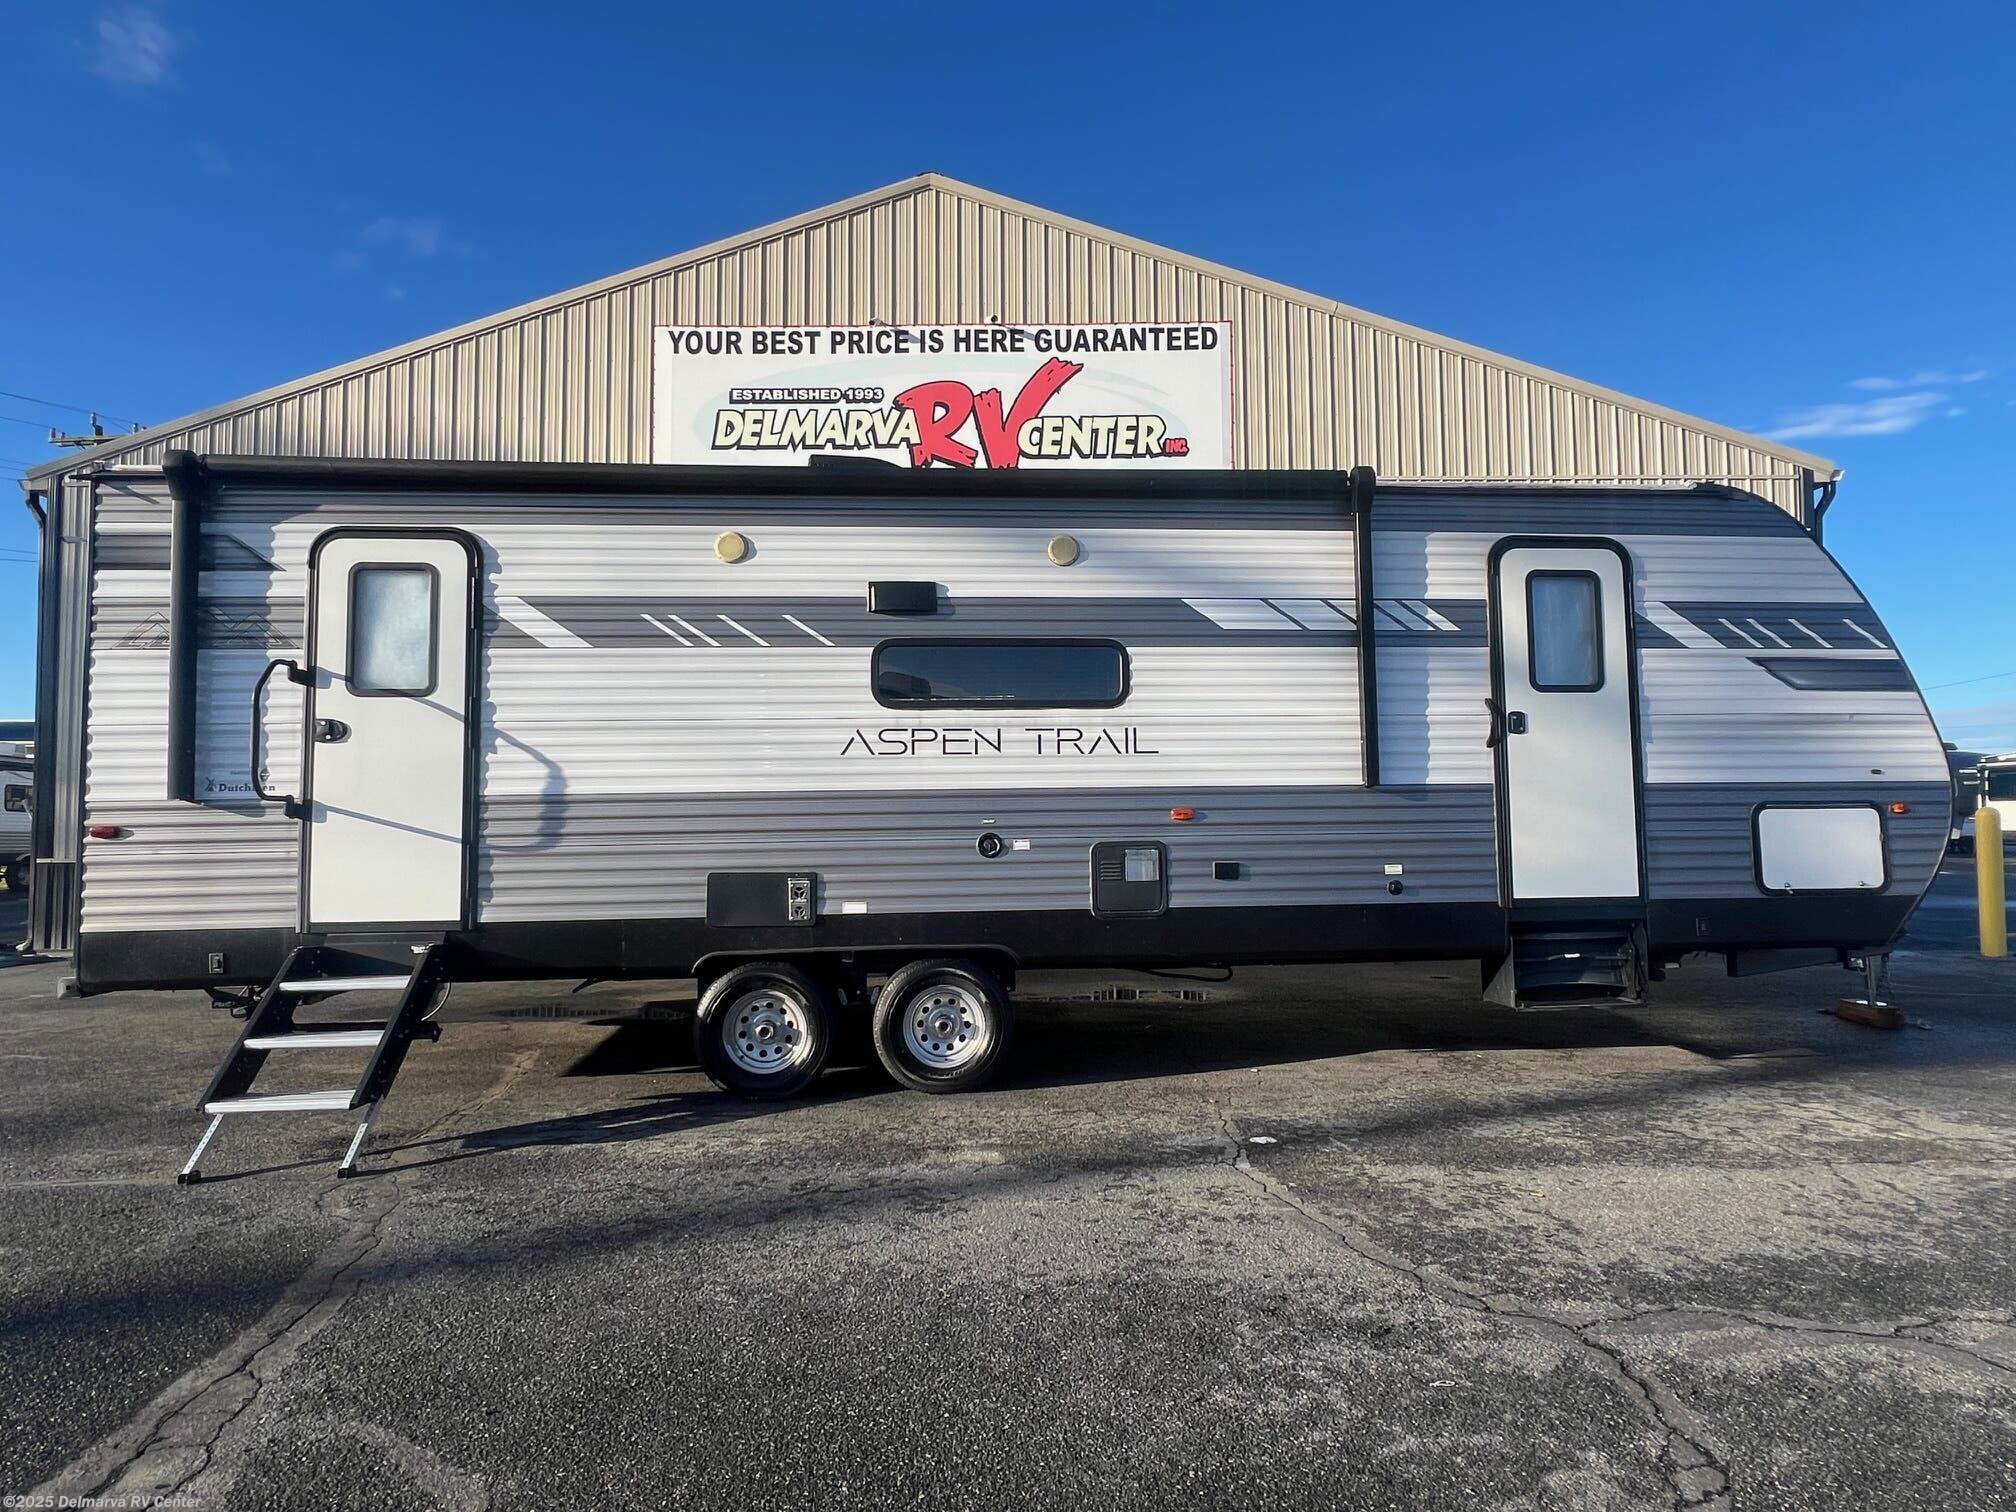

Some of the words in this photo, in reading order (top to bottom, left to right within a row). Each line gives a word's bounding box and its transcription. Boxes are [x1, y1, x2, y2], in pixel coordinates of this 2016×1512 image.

[668, 330, 743, 355] YOUR
[752, 330, 820, 354] BEST
[830, 329, 910, 354] PRICE
[919, 328, 944, 353] IS
[954, 328, 1025, 353] HERE
[1034, 326, 1218, 352] GUARANTEED
[730, 388, 843, 402] ESTABLISHED
[844, 388, 884, 402] 1993
[711, 408, 922, 451] DELMARVA
[894, 356, 1084, 469] RV
[1017, 415, 1167, 459] CENTER
[840, 728, 1002, 756] ASPEN
[1024, 727, 1160, 755] TRAIL
[218, 783, 276, 792] Dutchen
